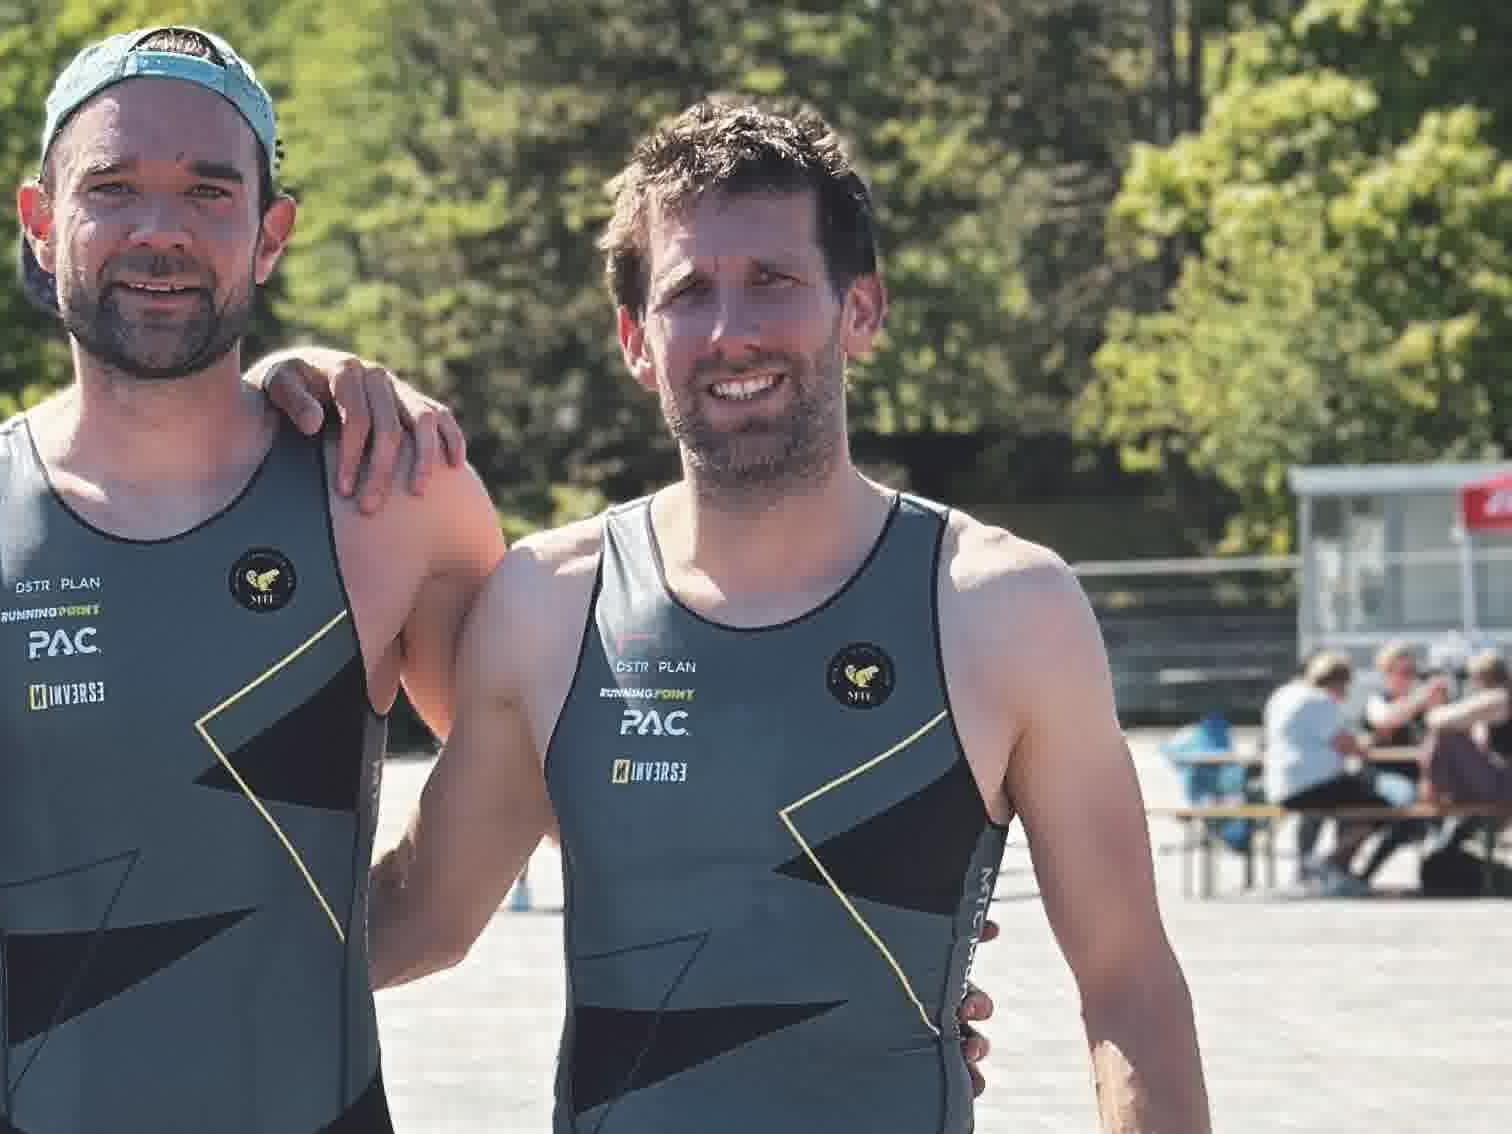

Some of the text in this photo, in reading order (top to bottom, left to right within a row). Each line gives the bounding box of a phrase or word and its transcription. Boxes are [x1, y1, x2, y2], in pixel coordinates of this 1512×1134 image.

[16, 576, 101, 593] DSTR PLAN
[658, 660, 697, 673] PLAN
